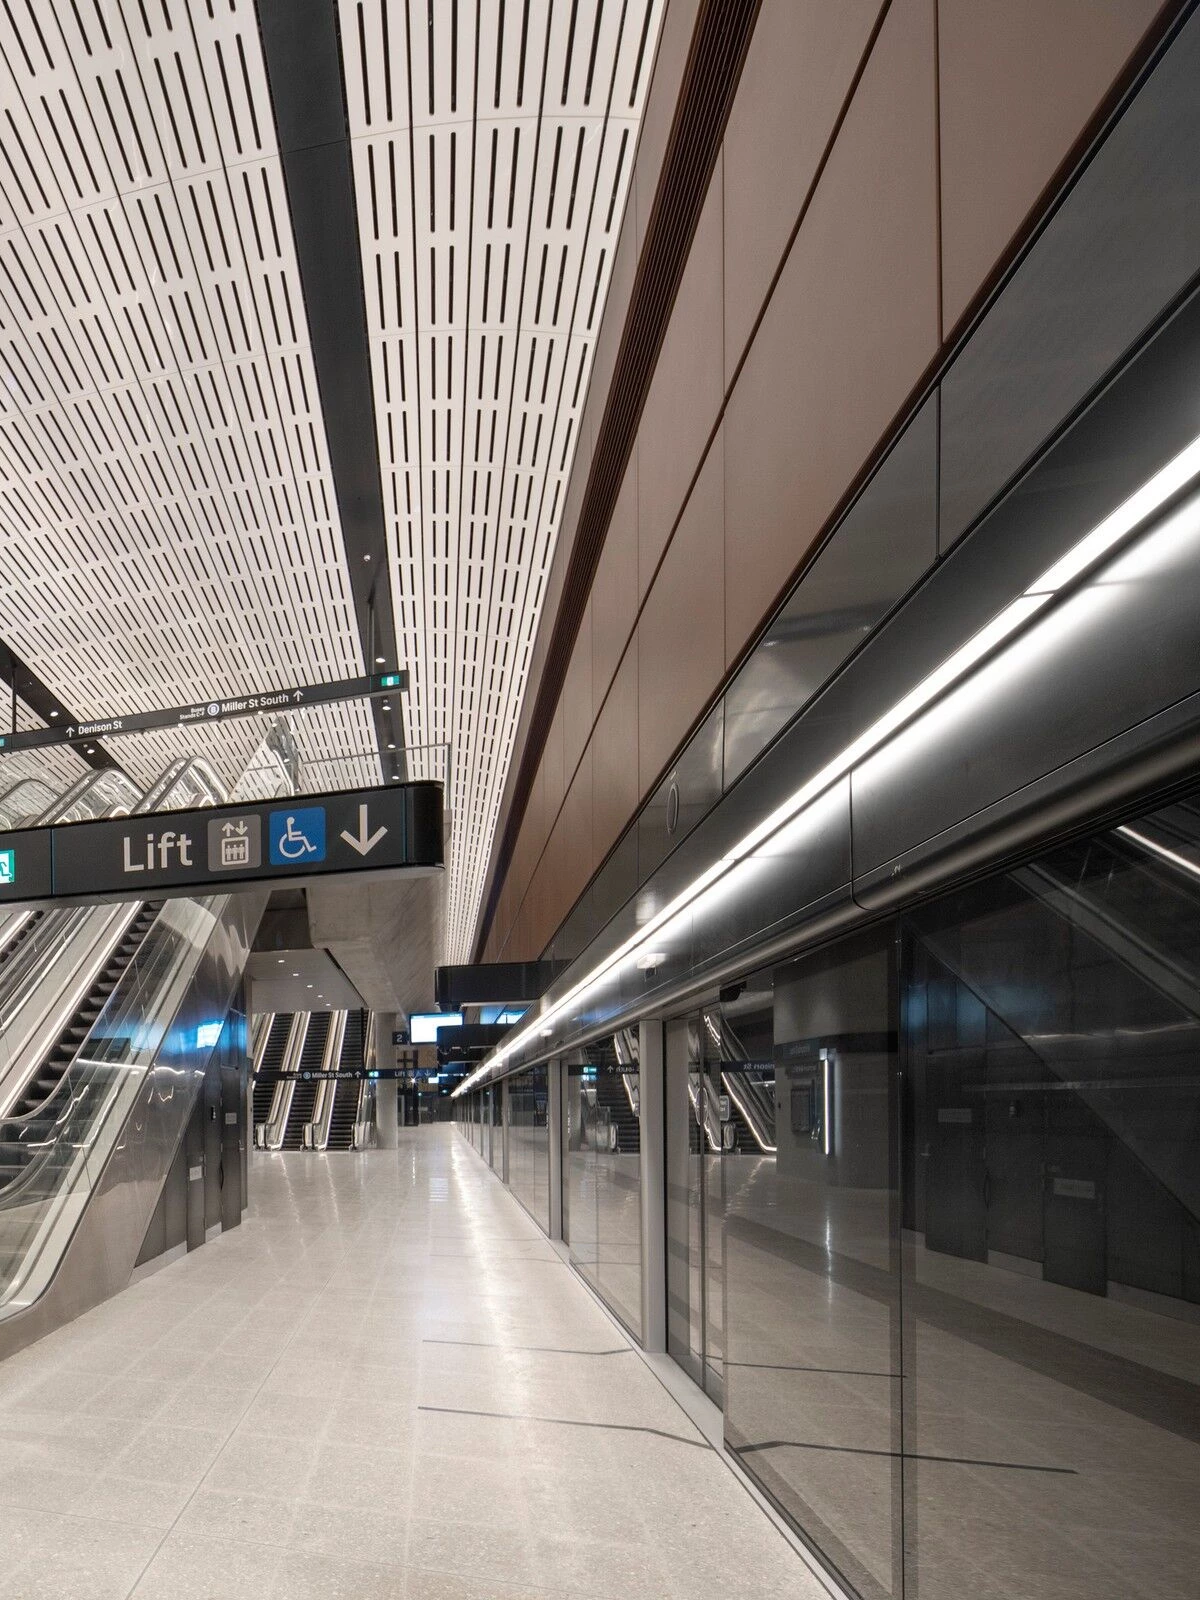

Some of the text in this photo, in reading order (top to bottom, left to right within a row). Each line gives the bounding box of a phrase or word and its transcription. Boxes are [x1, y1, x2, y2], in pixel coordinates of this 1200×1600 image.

[221, 694, 289, 713] Miller St South
[78, 720, 123, 735] Denison St
[123, 831, 192, 873] Lift
[396, 1034, 403, 1043] 2
